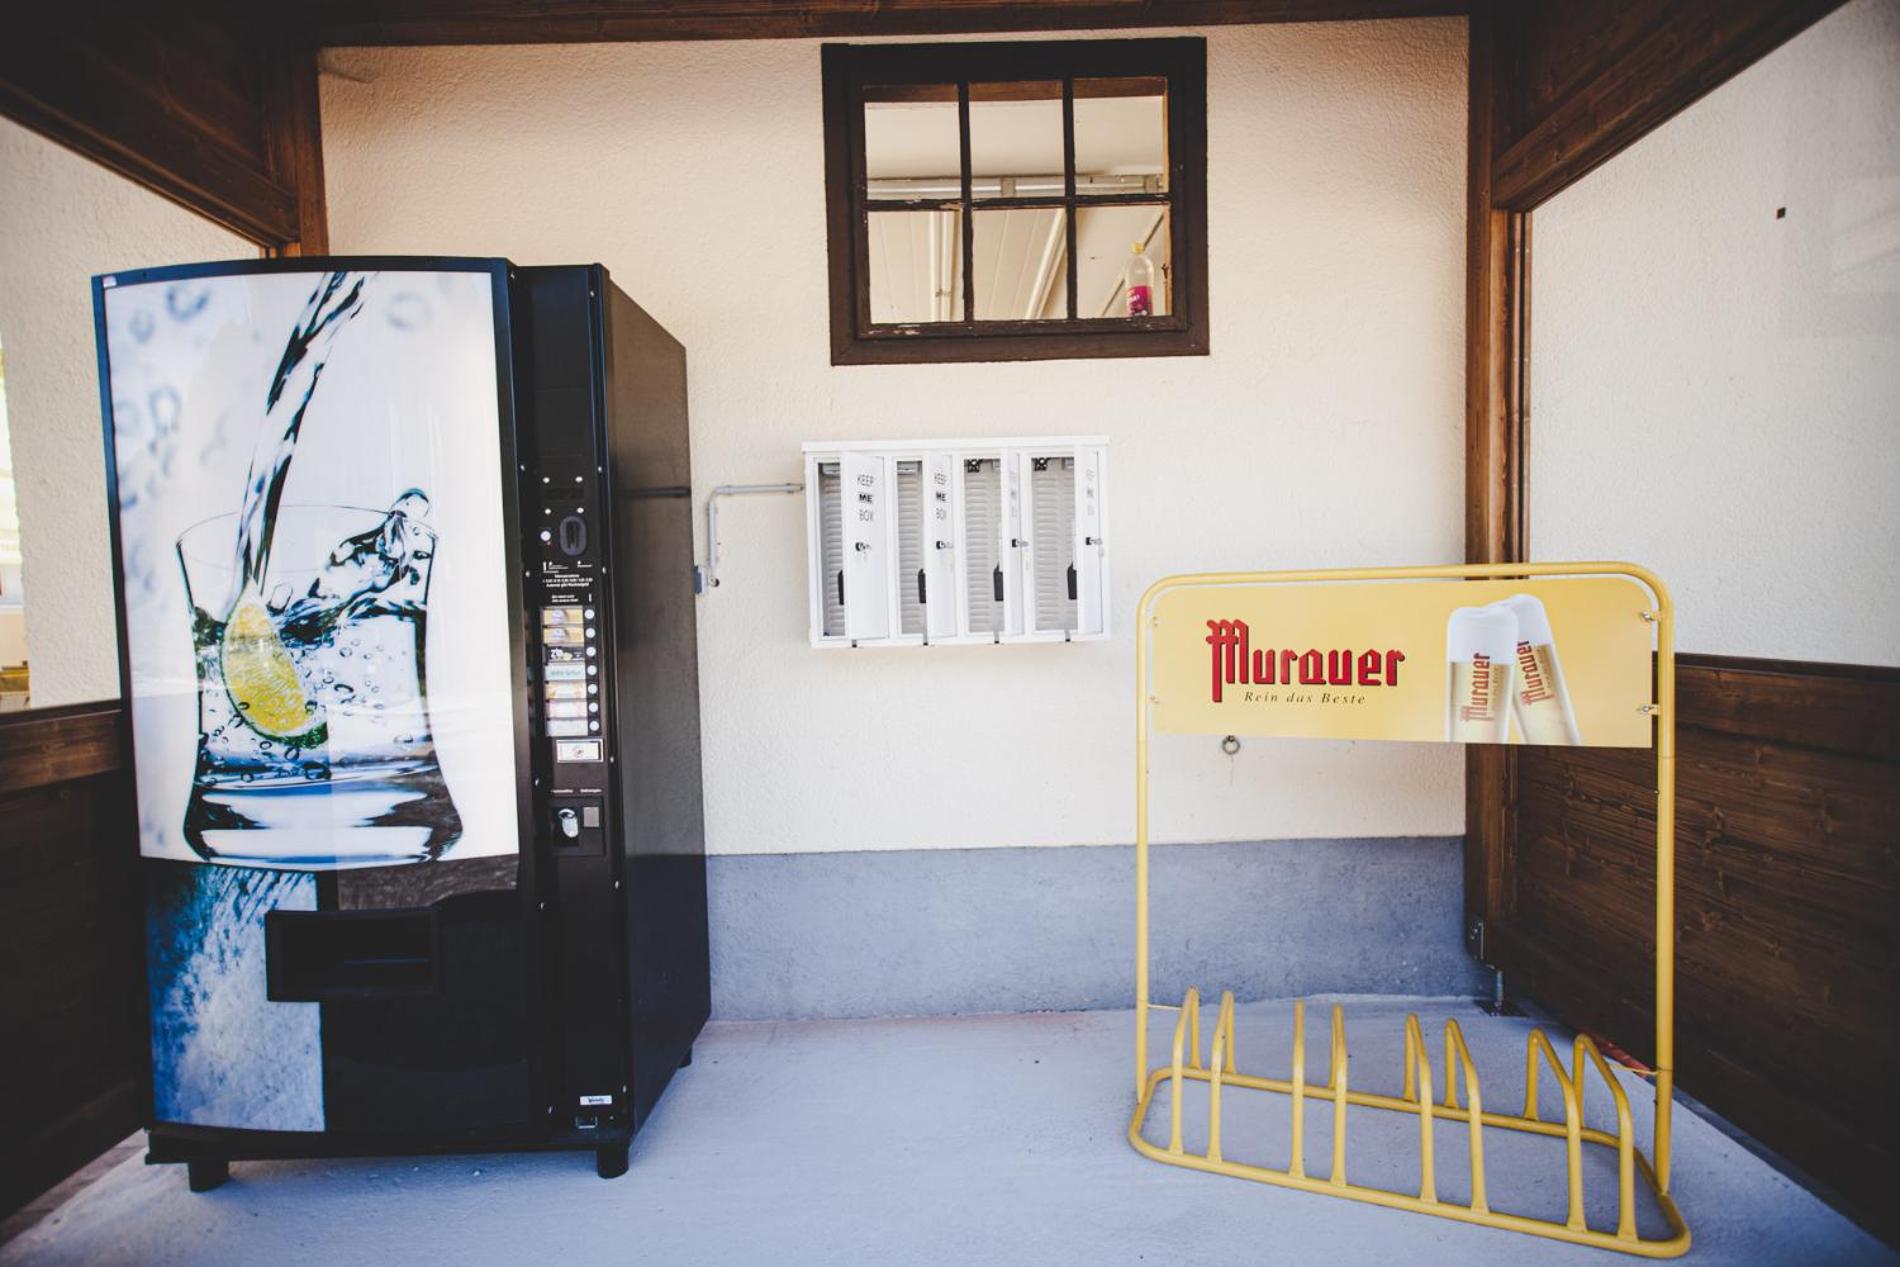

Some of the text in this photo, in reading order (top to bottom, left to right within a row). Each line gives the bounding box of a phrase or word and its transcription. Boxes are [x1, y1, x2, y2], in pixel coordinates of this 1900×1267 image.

[859, 493, 873, 503] ME
[1205, 619, 1405, 703] Murauer
[1461, 652, 1494, 722] Murauer
[1517, 640, 1557, 705] Murauer
[1244, 690, 1365, 705] Rein das Beste
